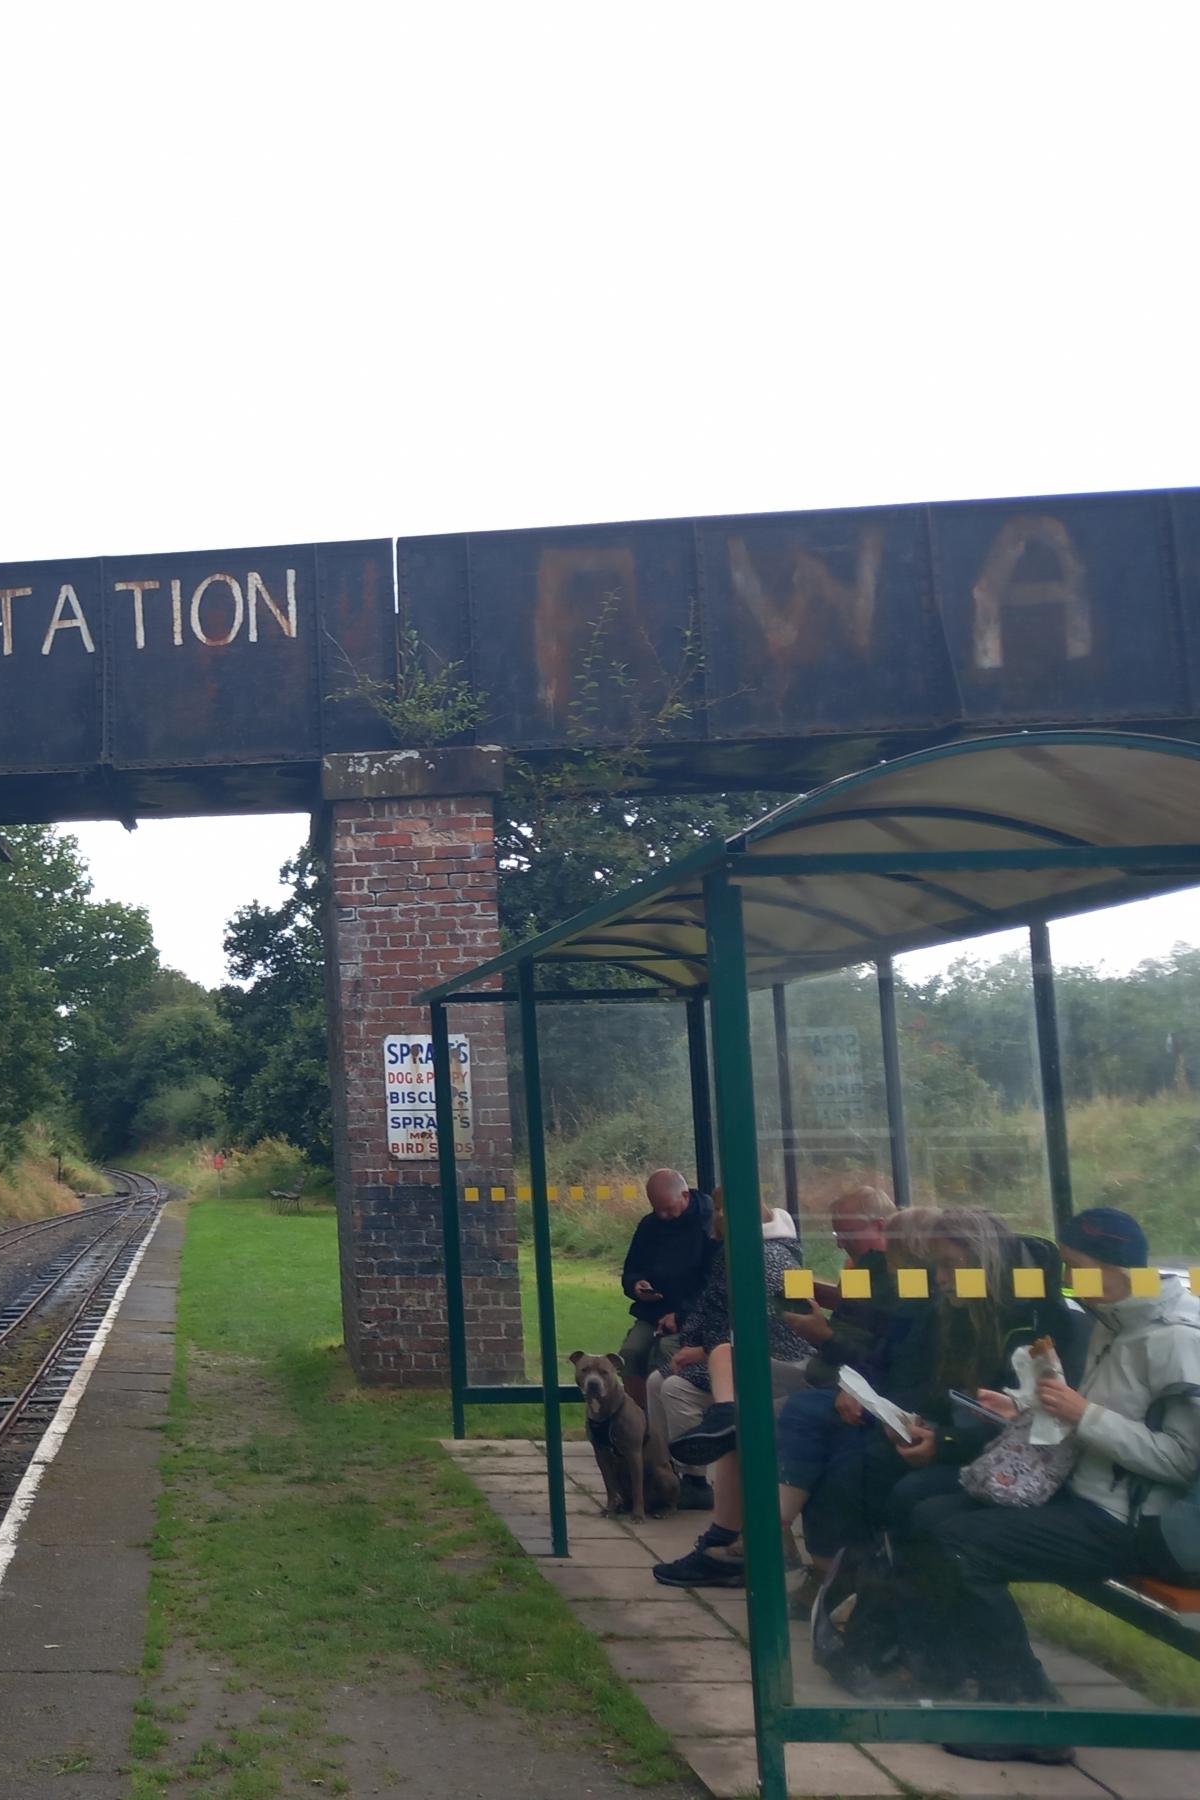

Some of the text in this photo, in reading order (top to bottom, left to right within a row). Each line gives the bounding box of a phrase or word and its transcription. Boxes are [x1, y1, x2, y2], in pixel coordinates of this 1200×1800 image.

[387, 1040, 469, 1065] SPRA'S
[388, 1071, 468, 1084] DOG & PPY
[389, 1091, 469, 1105] BISCUS
[390, 1114, 471, 1129] SPRA'S
[391, 1142, 474, 1154] BIRD SDS
